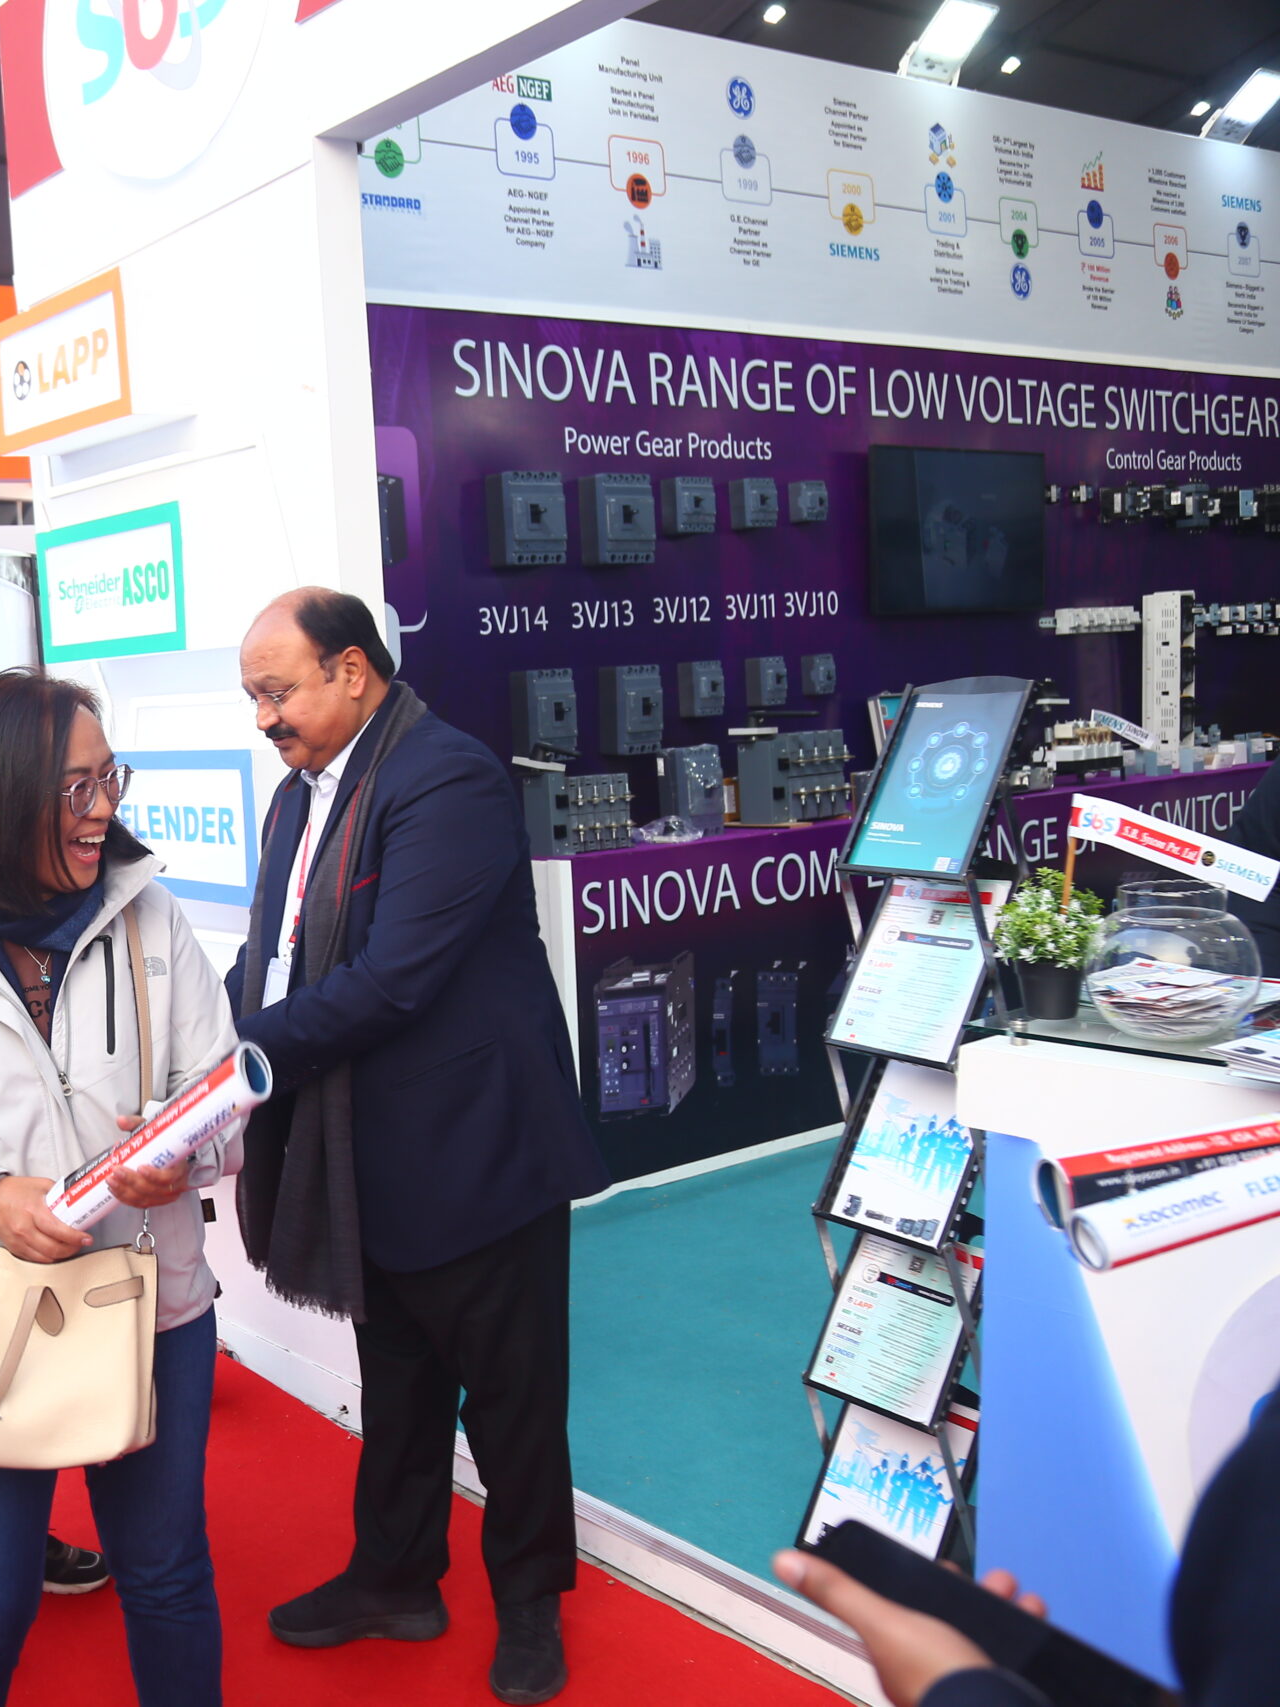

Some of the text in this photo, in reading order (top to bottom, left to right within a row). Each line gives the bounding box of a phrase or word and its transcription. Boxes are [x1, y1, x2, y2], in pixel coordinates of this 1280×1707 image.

[621, 56, 640, 67] Panel
[598, 64, 663, 83] Manufacturing Unit
[492, 75, 551, 99] AEG NGEF
[610, 87, 655, 101] Started Panel
[611, 97, 655, 112] Manufacturing
[833, 98, 856, 109] Siemens
[609, 107, 621, 116] Unit
[629, 111, 659, 123] Faridabad
[824, 107, 868, 121] Channel Partner
[831, 121, 856, 132] Appointed
[828, 130, 867, 143] Channel Partner
[515, 150, 539, 165] 1995
[626, 151, 650, 165] 1996
[737, 178, 758, 192] 1999
[842, 184, 861, 195] 2000
[361, 193, 421, 210] STANDARD
[1221, 195, 1262, 213] SIEMENS
[509, 205, 541, 216] Appointed
[938, 212, 956, 223] 2001
[1011, 210, 1027, 221] 2004
[504, 214, 554, 228] Channel Partner
[743, 216, 768, 227] Channel
[506, 226, 515, 234] for
[738, 227, 760, 237] Partner
[516, 238, 545, 249] Company
[733, 238, 759, 248] Appointed
[936, 240, 954, 251] Trading
[1090, 236, 1105, 248] 2005
[1164, 235, 1178, 246] 2006
[729, 247, 772, 259] Channel Partner
[829, 243, 880, 261] SIEMENS
[934, 250, 963, 260] Distribution
[1238, 256, 1251, 265] 2007
[37, 328, 109, 394] LAPP
[453, 338, 636, 404] SINOVA
[649, 352, 795, 413] RANGE
[806, 363, 856, 416] OF
[869, 368, 948, 421] LOW
[956, 374, 1097, 429] VOLTAGE
[564, 426, 772, 460] Power Gear Products
[1106, 448, 1242, 472] Control Gear Products
[58, 560, 170, 607] Schneider ASCO
[479, 590, 839, 635] 3VJ14 3VJ13 3VJ12 3VJ11 3VJ10
[870, 821, 904, 832] SINOVA
[1215, 858, 1272, 887] SIEMENS
[582, 863, 741, 935] SINOVA
[180, 1080, 210, 1112] Registered
[1104, 1147, 1161, 1167] Registered
[1138, 1191, 1223, 1224] socomec
[853, 1300, 874, 1310] LAPP
